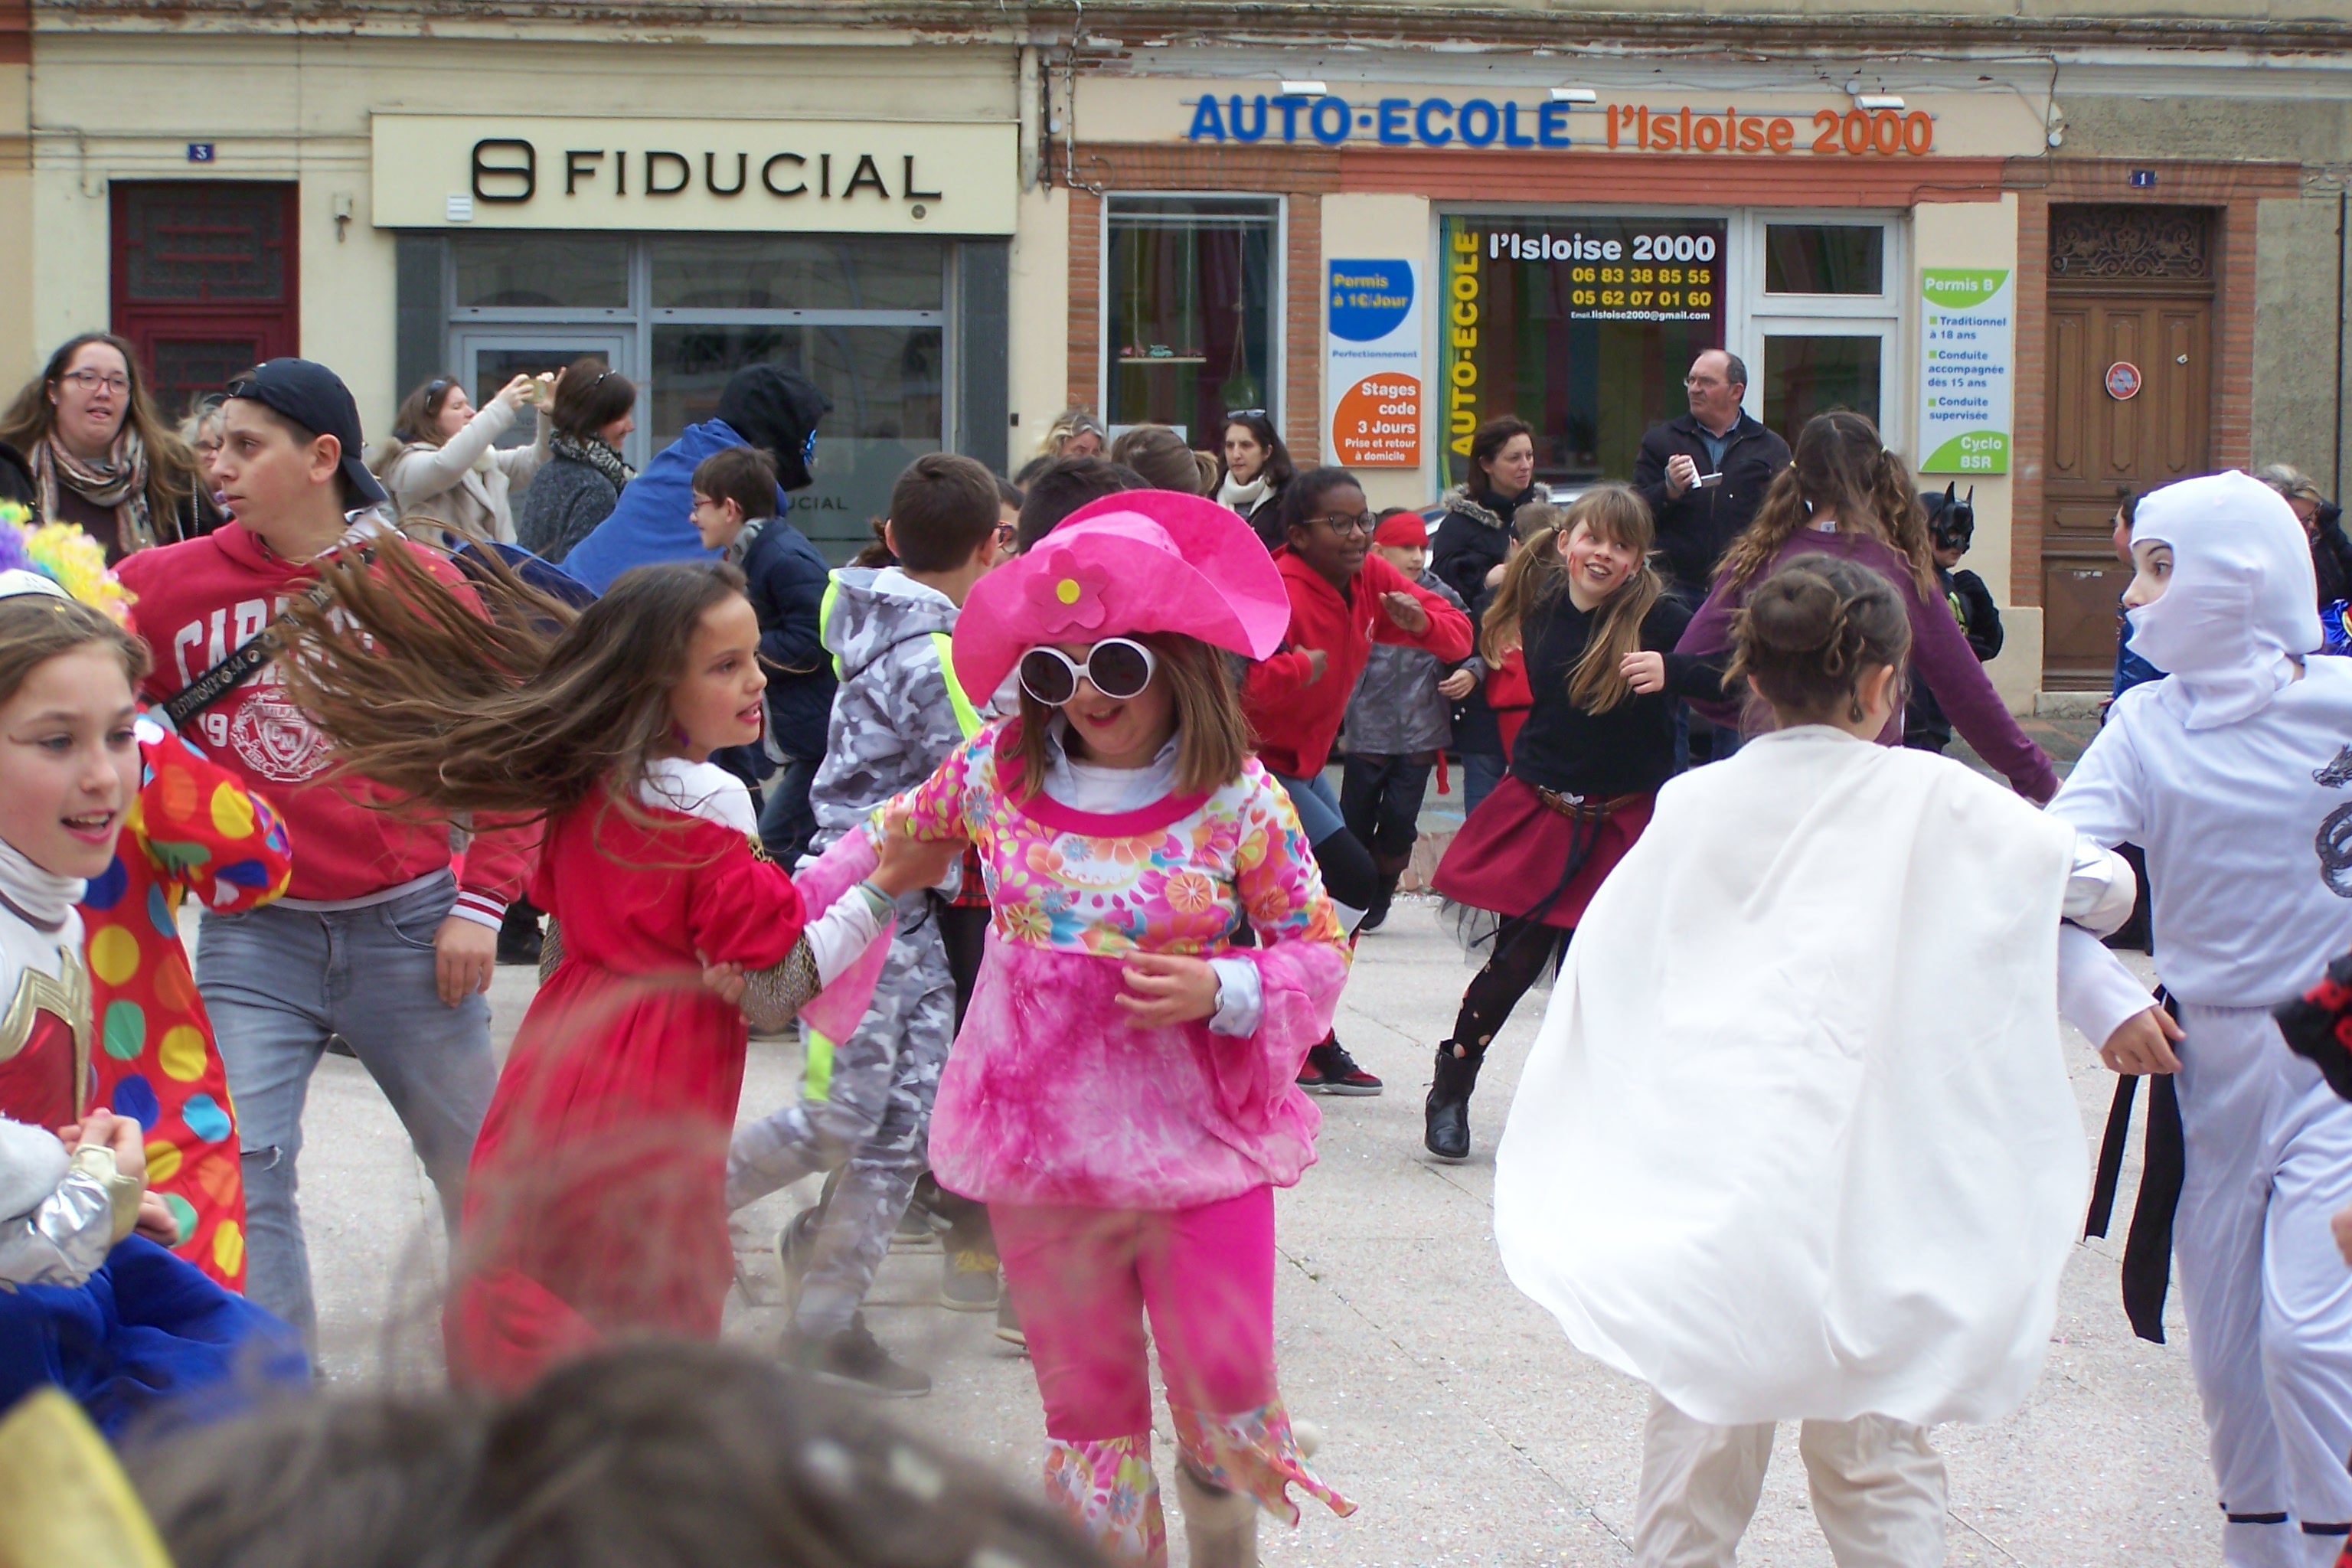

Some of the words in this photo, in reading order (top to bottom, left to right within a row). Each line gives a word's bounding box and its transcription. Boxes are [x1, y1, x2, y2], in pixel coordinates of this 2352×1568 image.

[1607, 104, 1795, 152] l'Isloise
[1812, 109, 1933, 155] 2000
[196, 145, 207, 160] 3
[565, 151, 942, 201] FIDUCIAL
[2139, 172, 2146, 185] 1
[1489, 233, 1622, 260] l'Isloise
[1632, 235, 1716, 262] 2000
[1332, 273, 1389, 288] Permis
[1572, 268, 1596, 284] 06
[1601, 268, 1624, 284] 83
[1630, 268, 1653, 284] 38
[1658, 268, 1682, 284] 85
[1687, 268, 1711, 284] 55
[1925, 276, 1978, 292] Permis
[1983, 279, 1993, 292] B
[1333, 292, 1344, 307] à
[1572, 290, 1596, 306] 05
[1602, 290, 1625, 306] 62
[1630, 290, 1653, 306] 07
[1658, 290, 1681, 306] 01
[1687, 290, 1712, 306] 60
[1940, 316, 2007, 326] Traditionnel
[1929, 330, 1936, 339] à
[1941, 331, 1953, 339] 18
[1332, 350, 1418, 358] Perfectionnement
[1939, 351, 1988, 360] Conduite
[1928, 364, 2005, 376] accompagnée
[1952, 377, 1964, 387] 15
[1361, 382, 1416, 399] Stages
[1378, 401, 1416, 415] code
[1939, 397, 1989, 407] Conduite
[1929, 410, 1989, 421] supervisée
[1357, 420, 1367, 434] 3
[1372, 420, 1416, 435] Jours
[1344, 437, 1370, 448] Prise
[1372, 438, 1383, 448] et
[1385, 438, 1416, 448] retour
[1961, 436, 2002, 452] Cyclo
[1355, 450, 1362, 461] à
[1364, 451, 1406, 461] domicile
[1960, 456, 1991, 469] BSR
